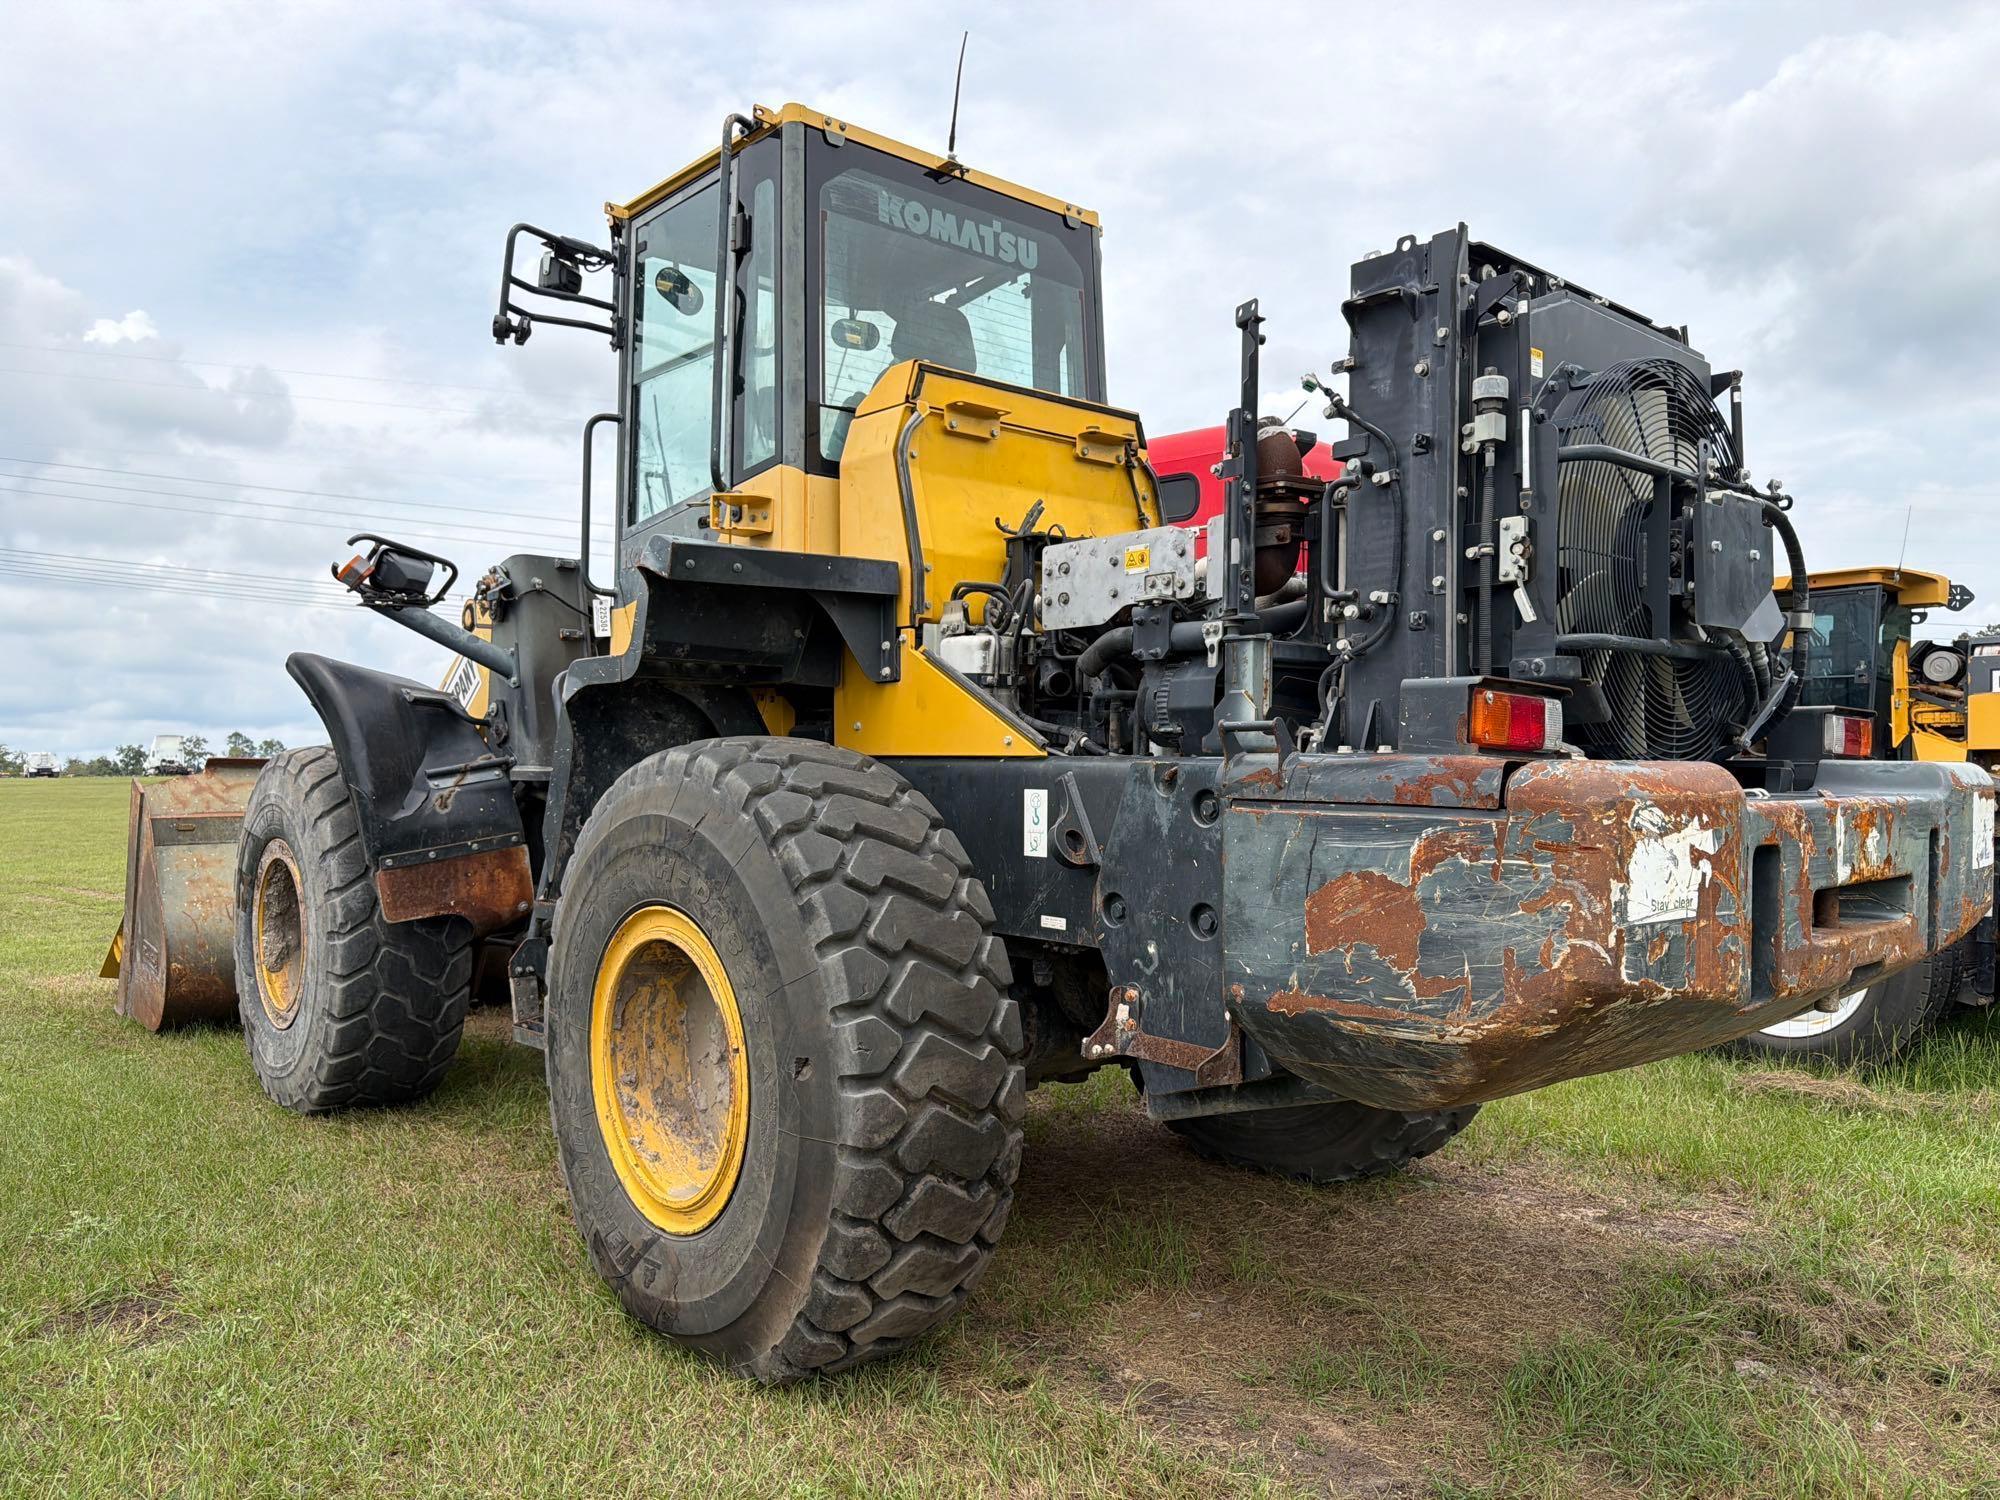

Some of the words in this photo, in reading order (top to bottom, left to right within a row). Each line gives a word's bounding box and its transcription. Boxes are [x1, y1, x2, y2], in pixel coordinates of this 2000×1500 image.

[877, 190, 1039, 269] KOMATSU
[451, 658, 477, 701] PANY
[1651, 898, 1669, 912] Stay
[1674, 896, 1694, 910] clear
